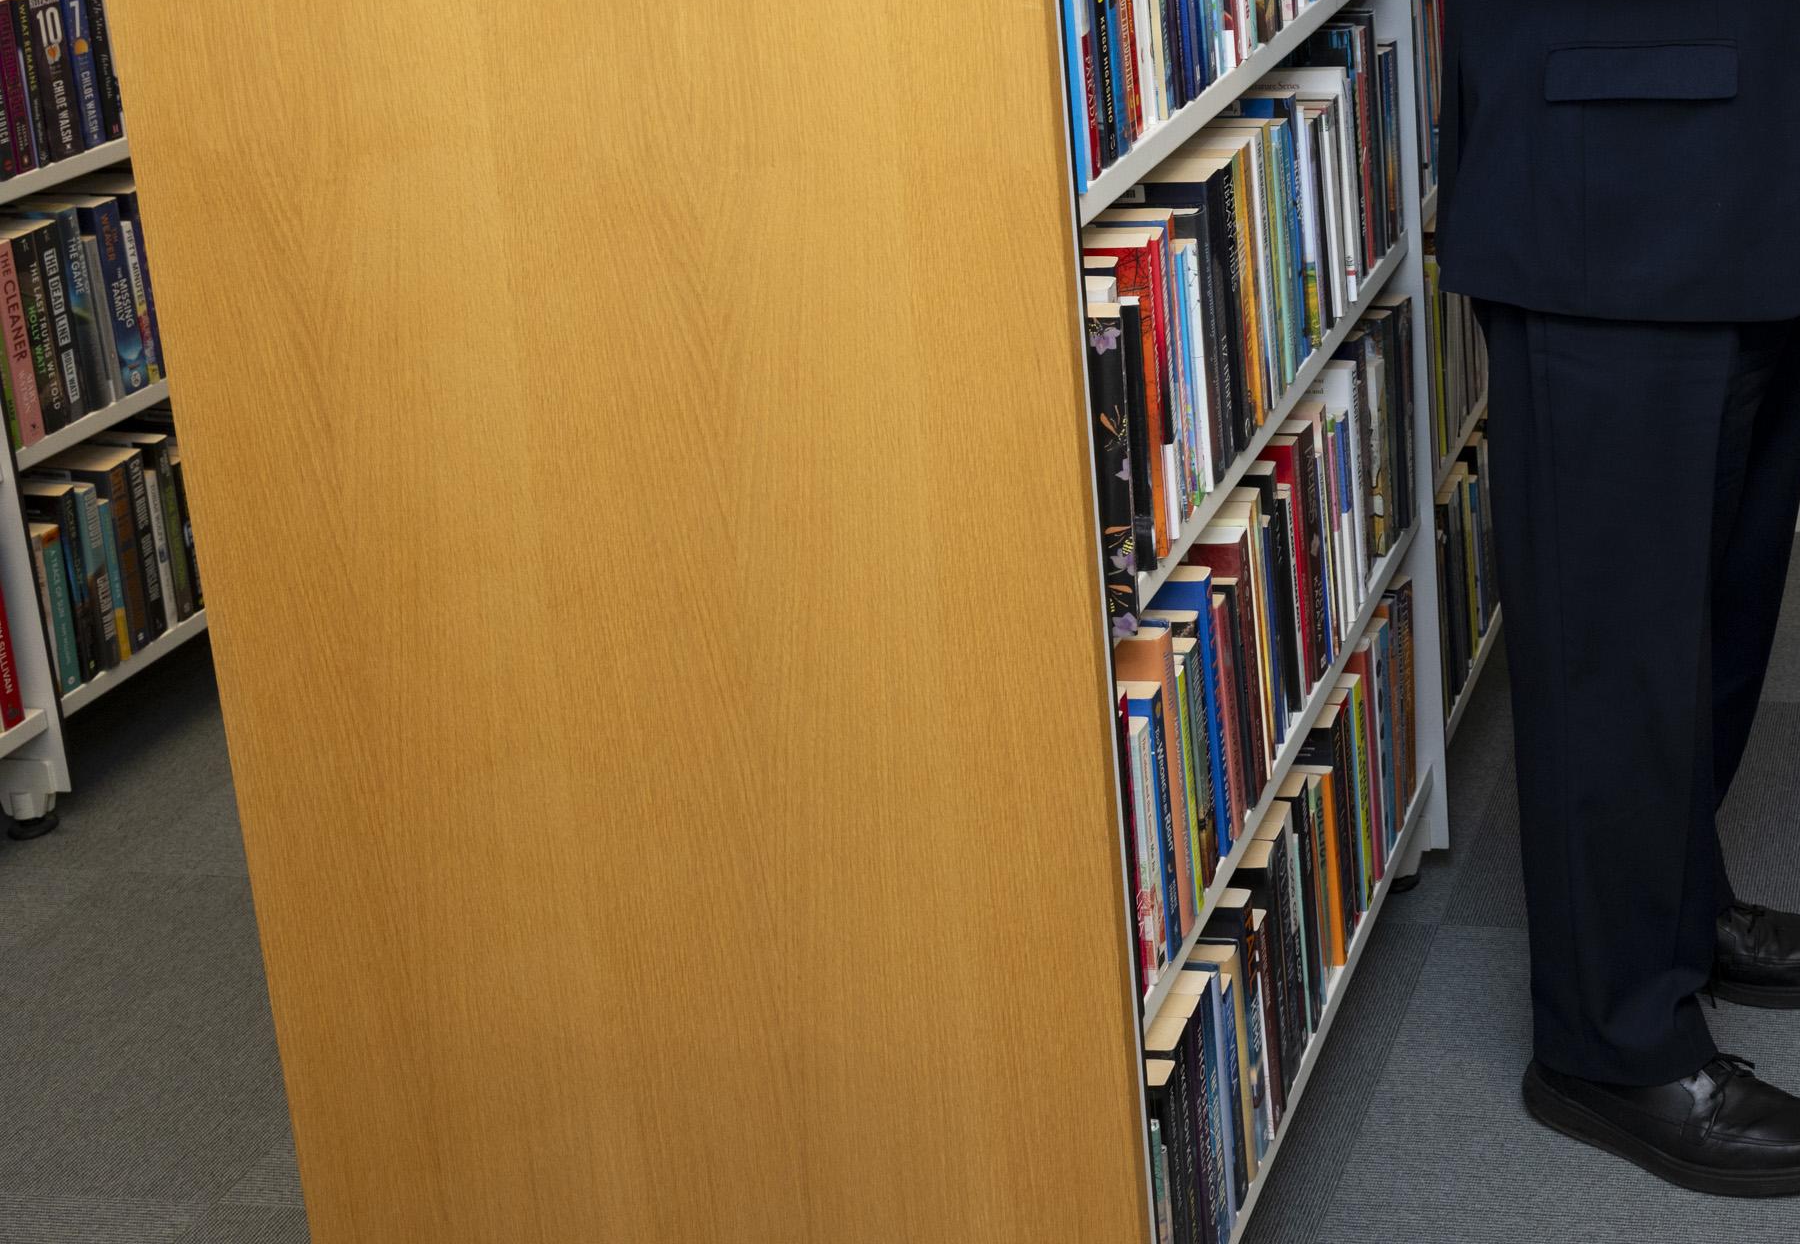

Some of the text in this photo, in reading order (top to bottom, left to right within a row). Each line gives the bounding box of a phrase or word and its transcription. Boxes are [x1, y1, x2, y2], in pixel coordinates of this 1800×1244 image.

[19, 4, 37, 91] WHAT REMAINS
[36, 7, 63, 48] 10
[69, 0, 81, 38] 7
[53, 80, 72, 143] CHLOE WALSH
[81, 71, 98, 132] CHLOE WALSH
[1085, 54, 1095, 127] PARADE
[1104, 57, 1112, 122] HIGASHINO
[101, 213, 115, 261] WEAVER
[1224, 175, 1233, 238] LIBRARY
[68, 236, 84, 294] THE GAME
[125, 229, 145, 306] FIFTY MINUTES
[0, 251, 27, 361] THE CLEANER
[45, 251, 68, 344] THE DEAD LINE
[111, 282, 126, 321] FAMILY
[120, 279, 135, 328] MISSING
[28, 306, 45, 375] HOLLY WATT
[30, 262, 61, 410] THE LAST TRUTHS WE TOLD
[64, 352, 78, 398] HOLLY WATT
[1223, 364, 1232, 417] HYDER
[50, 558, 60, 583] TRACE
[132, 485, 160, 602] IN RUINS DON WINSLOW
[55, 586, 62, 597] OF
[56, 601, 65, 618] SUN
[96, 575, 115, 640] CALLAN WINK
[1314, 576, 1322, 641] KAGAWA
[0, 645, 13, 693] SULLIVAN
[1156, 745, 1174, 851] WRONG RIGHT
[1317, 796, 1325, 869] COLLIDE
[1136, 889, 1145, 936] LISA
[1226, 999, 1238, 1097] THE VILLA
[1251, 999, 1261, 1052] KEMP
[1180, 1066, 1191, 1141] SKELETON
[1198, 1050, 1208, 1119] HOUSE
[1204, 1121, 1209, 1135] OF
[1204, 1137, 1216, 1225] MIRRORS
